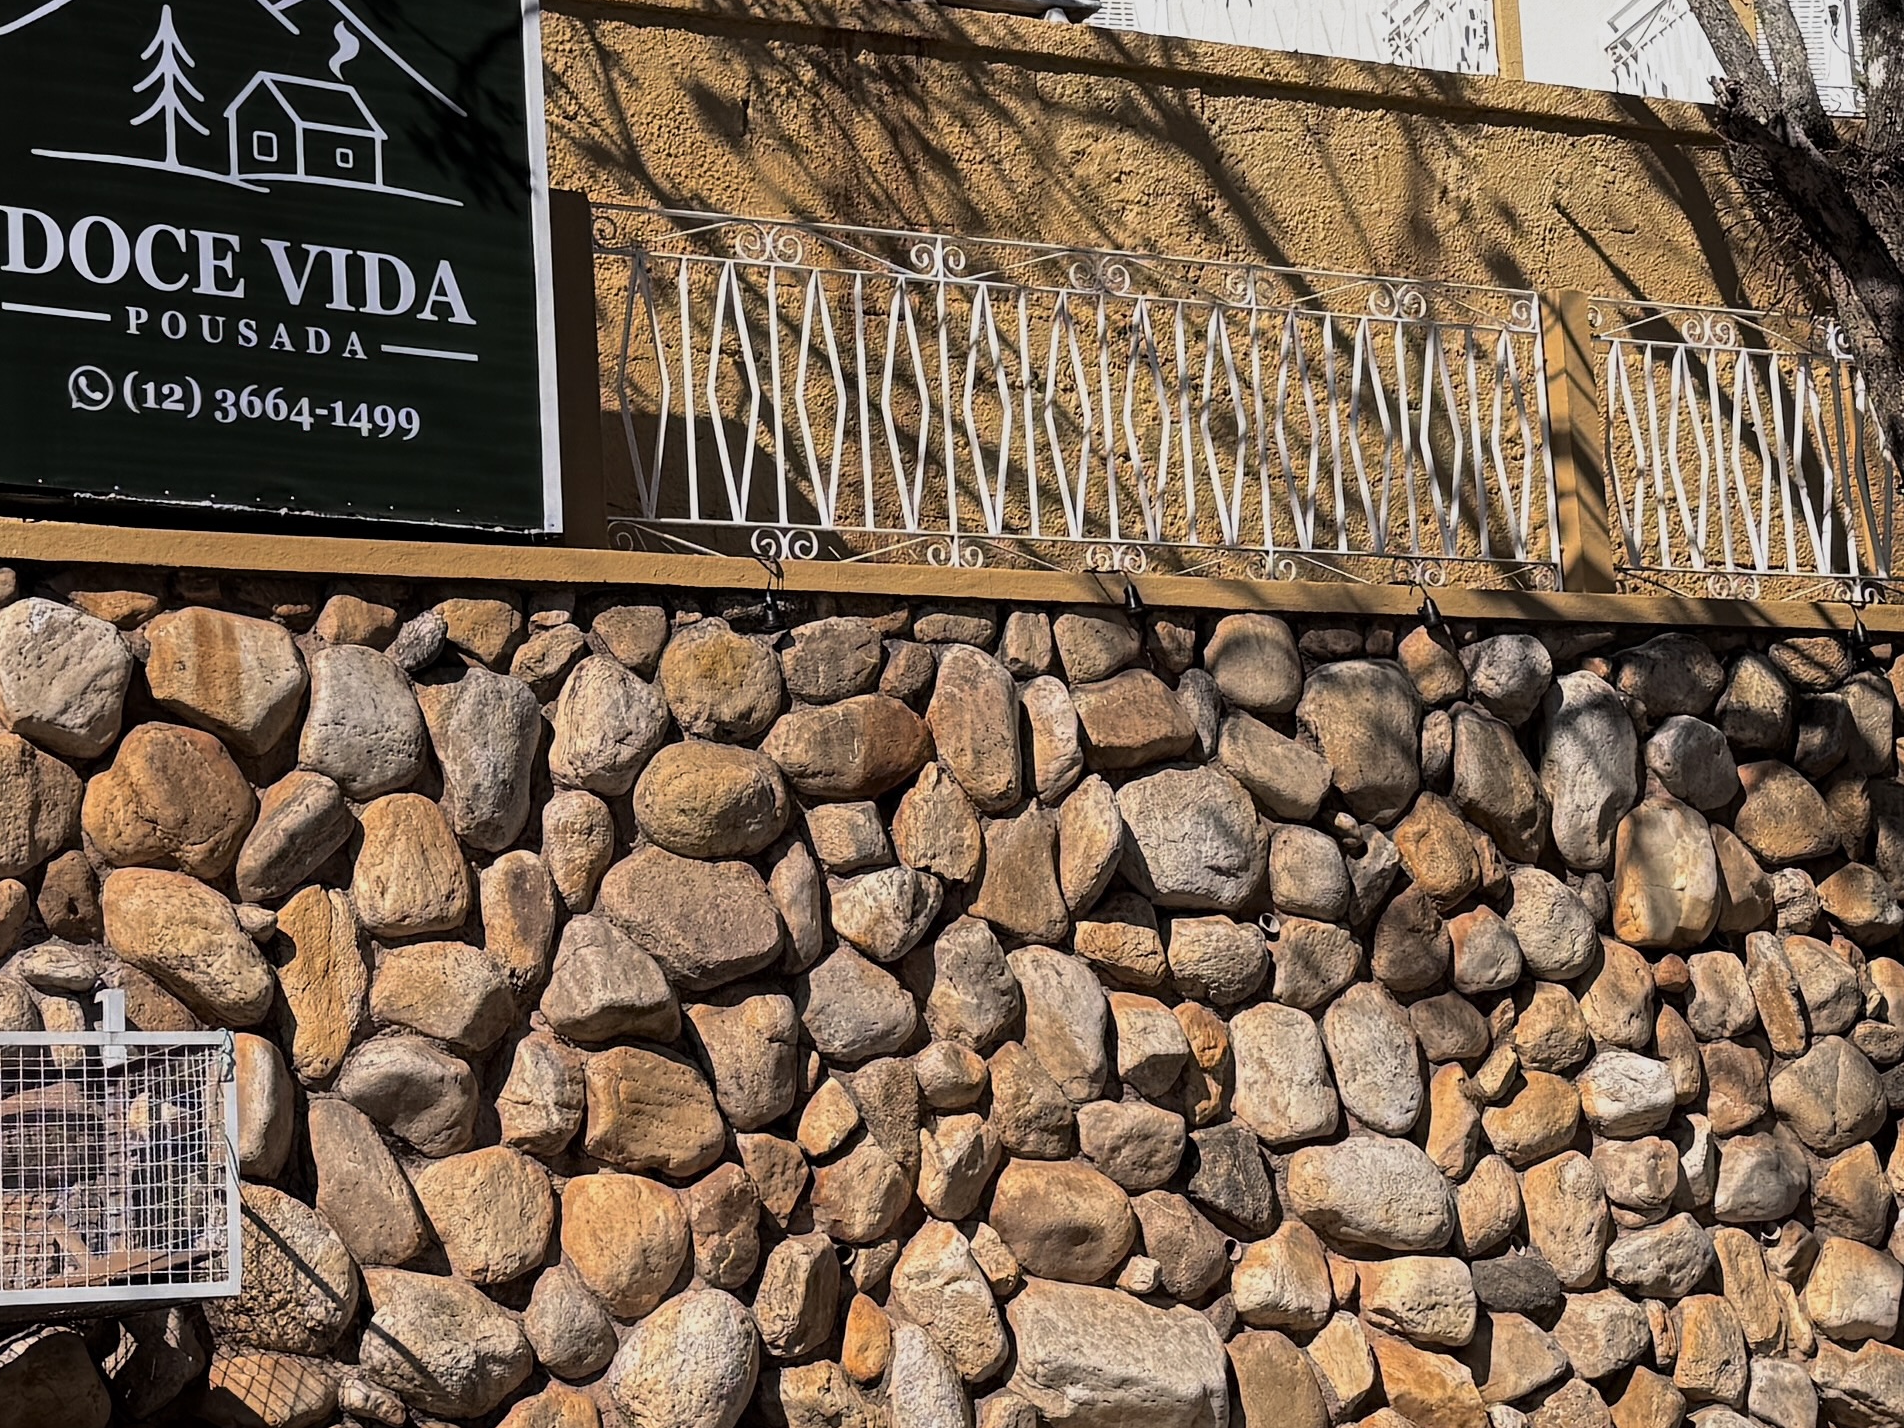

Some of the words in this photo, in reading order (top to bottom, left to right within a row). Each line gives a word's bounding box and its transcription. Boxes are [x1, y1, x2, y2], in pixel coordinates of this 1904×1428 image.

[260, 238, 478, 326] VIDA
[124, 305, 368, 360] POUSADA
[122, 371, 202, 419] (12)
[213, 384, 421, 441] 3664-1499
